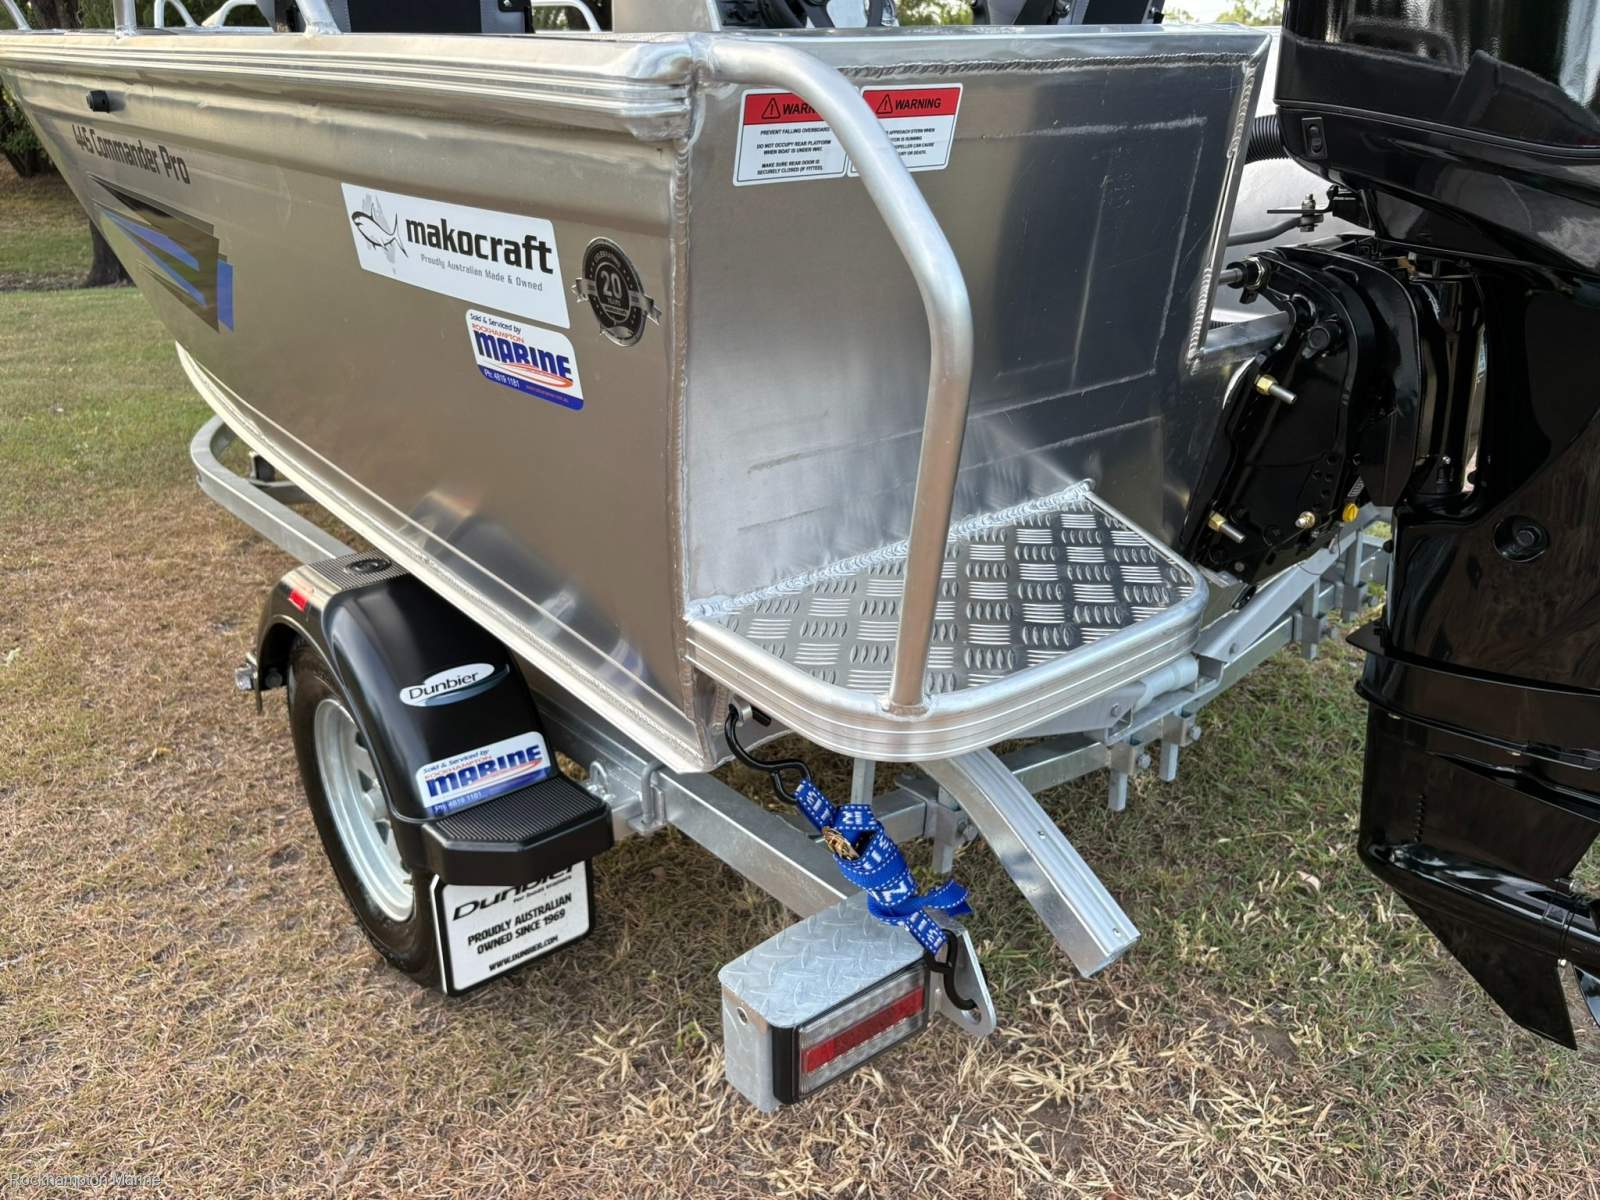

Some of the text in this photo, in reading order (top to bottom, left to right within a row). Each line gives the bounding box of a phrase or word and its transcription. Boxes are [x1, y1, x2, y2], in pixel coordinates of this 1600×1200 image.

[783, 103, 817, 115] WARN
[895, 98, 941, 110] WARNING
[72, 124, 191, 184] 445 Commander Pro
[405, 218, 553, 274] makocraft
[420, 254, 543, 291] Proudly Australian Made & Owned
[601, 270, 622, 299] 20
[470, 312, 482, 322] Sold
[488, 318, 512, 331] Serviced
[513, 325, 522, 336] by
[473, 330, 573, 382] MARINE
[409, 671, 479, 700] Dunbier
[424, 763, 439, 773] Sold
[449, 752, 479, 766] Serviced
[426, 744, 543, 798] MARINE
[467, 892, 573, 947] PROUDLY AUSTRALIAN
[477, 908, 566, 955] OWNED SINCE 1969
